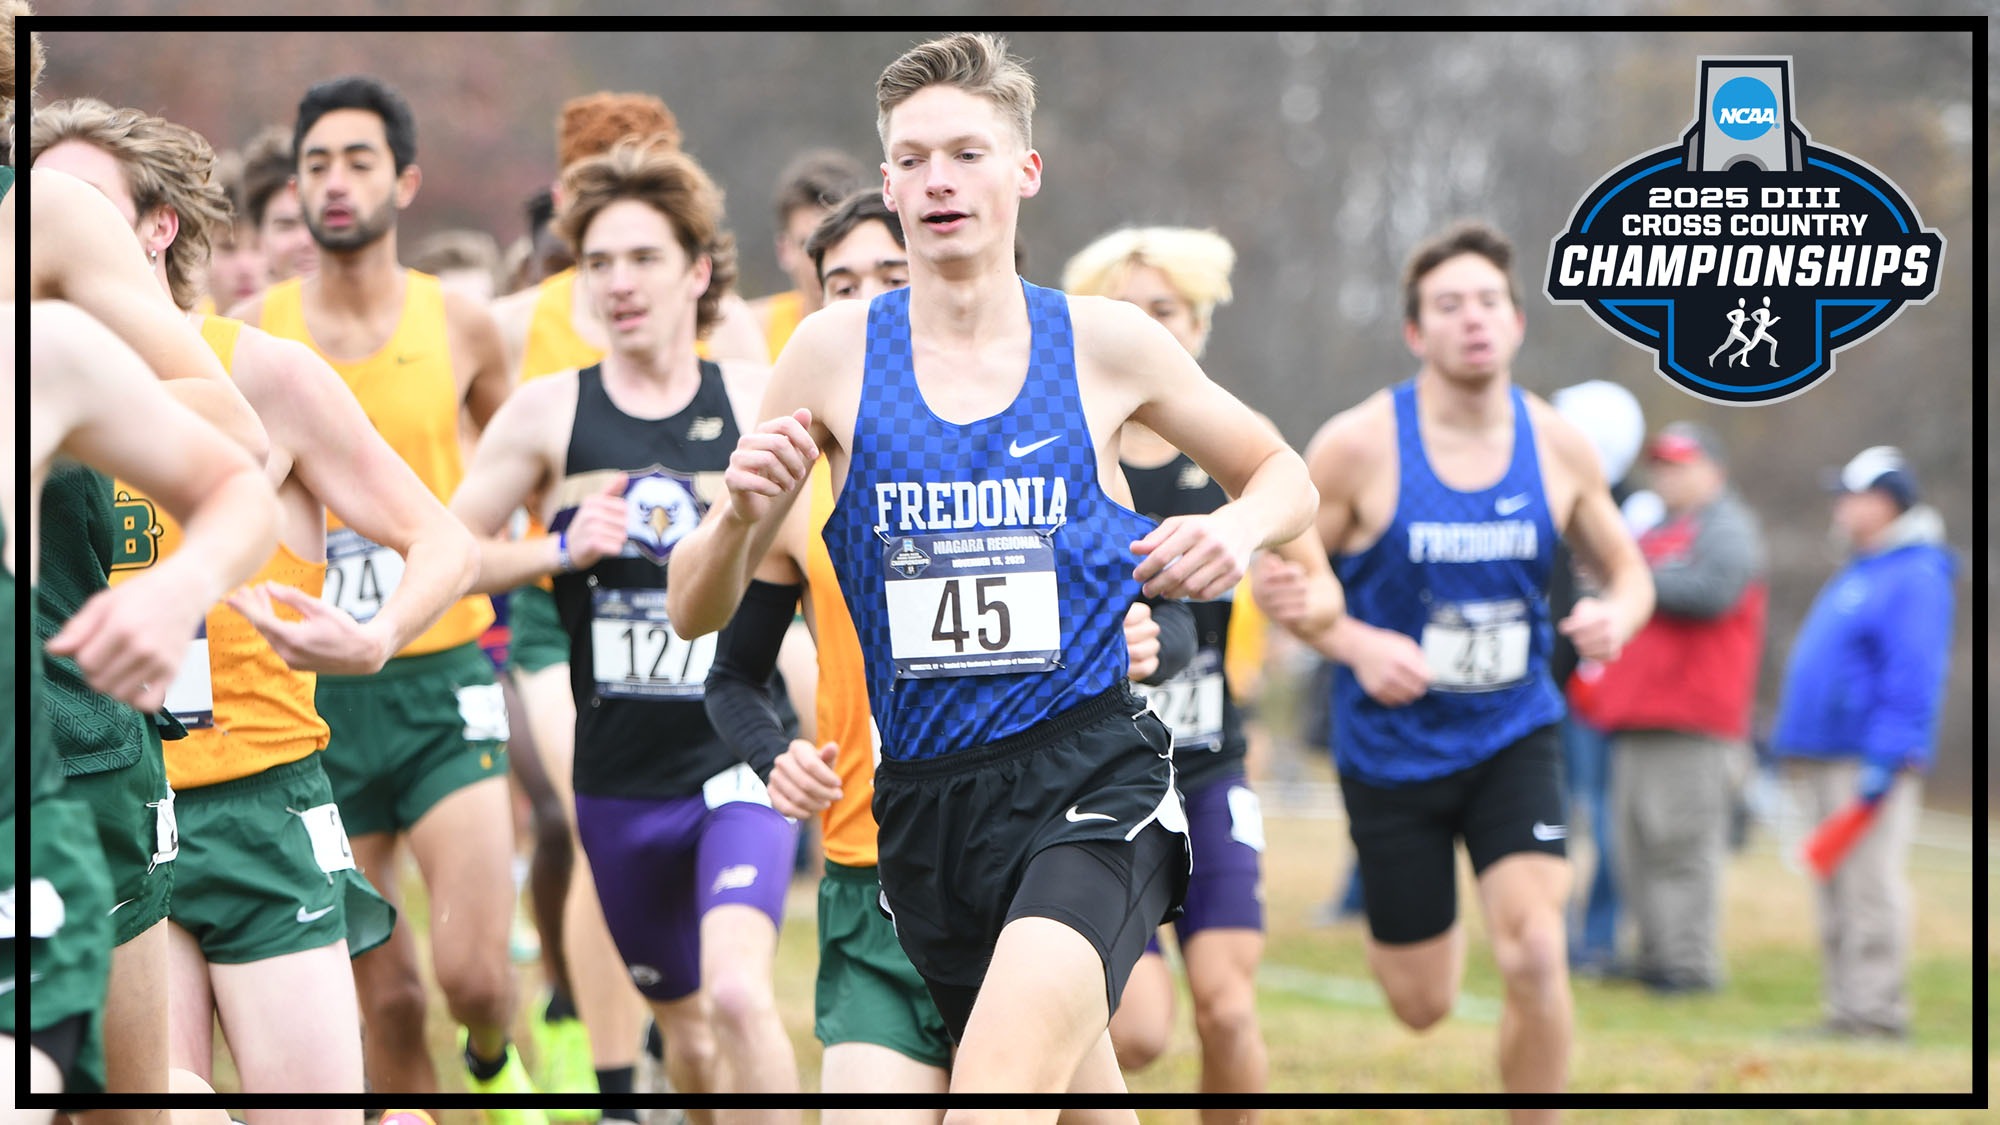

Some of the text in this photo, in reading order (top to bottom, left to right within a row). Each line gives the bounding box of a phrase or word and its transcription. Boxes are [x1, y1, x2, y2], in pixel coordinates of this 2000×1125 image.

[874, 476, 1068, 532] FREDONIA
[932, 535, 1043, 555] NIAGARA REGIONAL
[1408, 520, 1539, 564] FREDONIA
[931, 576, 1012, 653] 45
